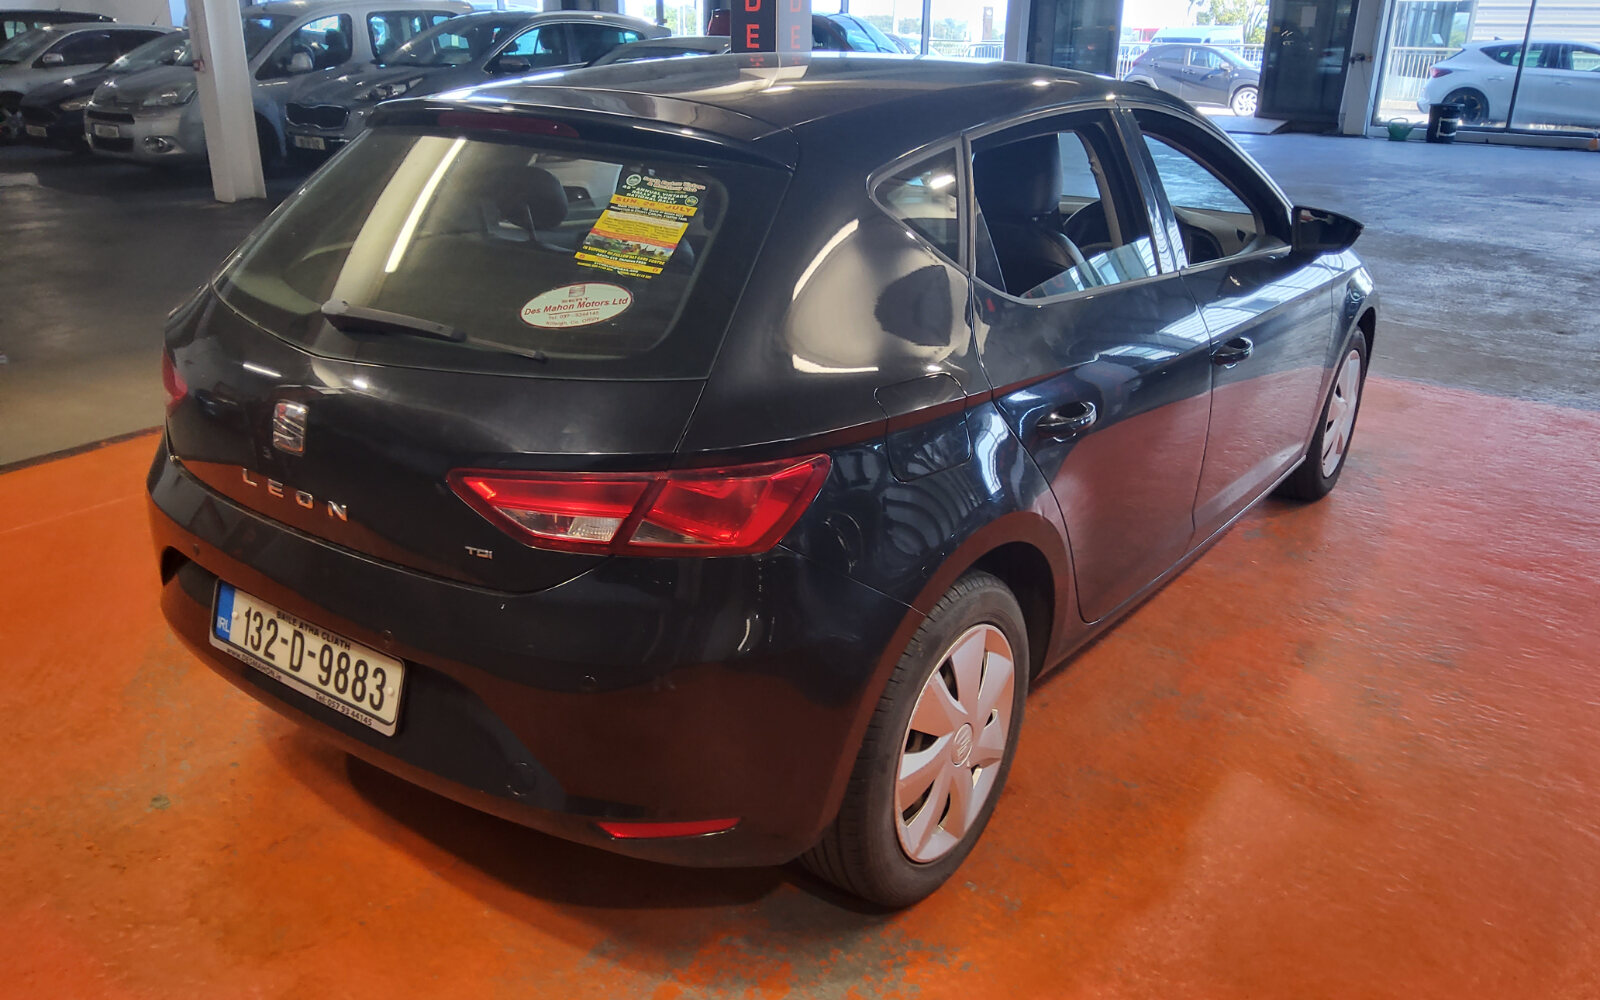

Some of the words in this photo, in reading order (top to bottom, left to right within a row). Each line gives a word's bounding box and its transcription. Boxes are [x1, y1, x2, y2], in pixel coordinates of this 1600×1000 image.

[665, 203, 692, 213] JULY
[543, 304, 575, 313] Mahon
[577, 300, 609, 309] Motors
[612, 297, 629, 305] Ltd
[242, 468, 348, 522] LEON
[464, 546, 493, 560] TDI
[217, 617, 230, 633] IRL
[276, 610, 297, 627] BAILE
[321, 631, 351, 651] CLIATH
[244, 606, 387, 712] 132-D-9883
[328, 699, 340, 710] 057
[340, 705, 350, 715] 93
[350, 711, 373, 726] 44145
